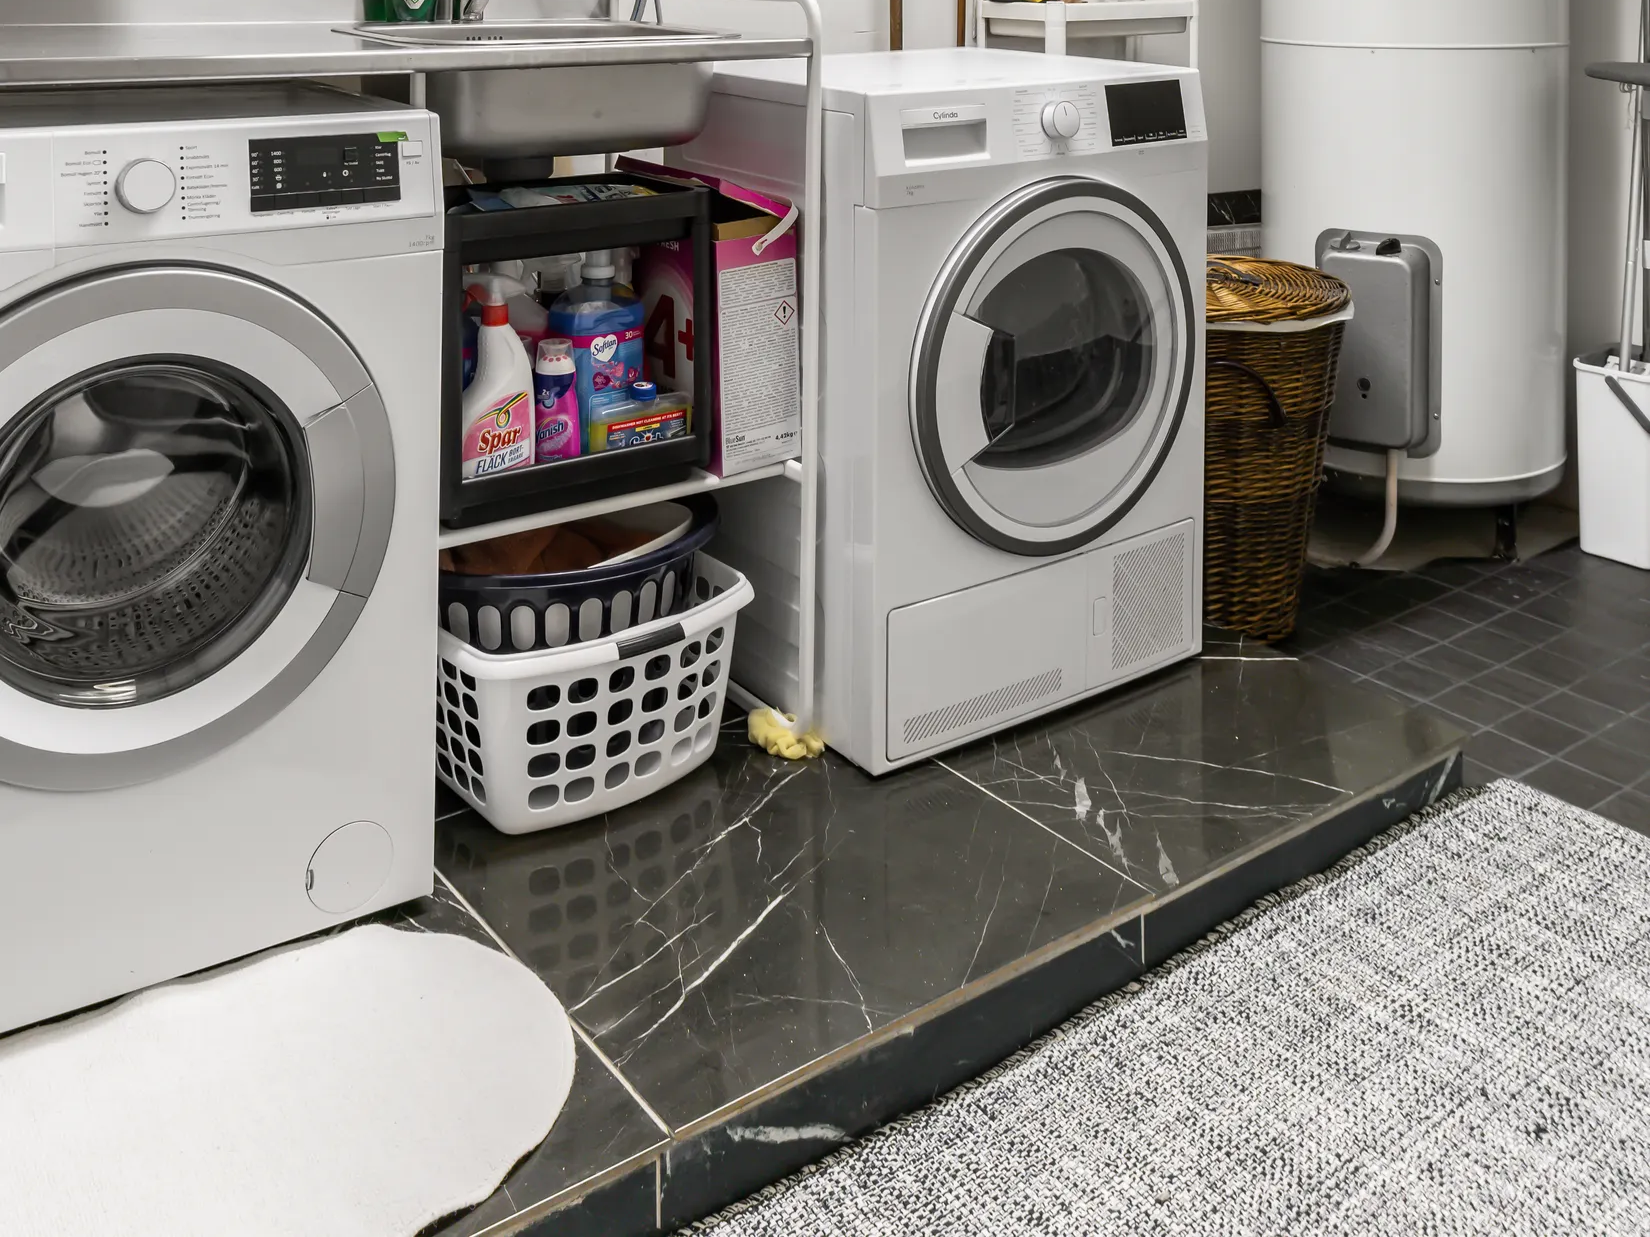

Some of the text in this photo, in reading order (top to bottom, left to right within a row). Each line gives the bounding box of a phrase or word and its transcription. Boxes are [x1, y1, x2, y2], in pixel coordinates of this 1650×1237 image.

[932, 111, 959, 120] Cylinda
[625, 330, 633, 340] 30
[592, 339, 617, 357] Softlan
[477, 426, 522, 455] Spar
[475, 450, 509, 475] FLÄCK
